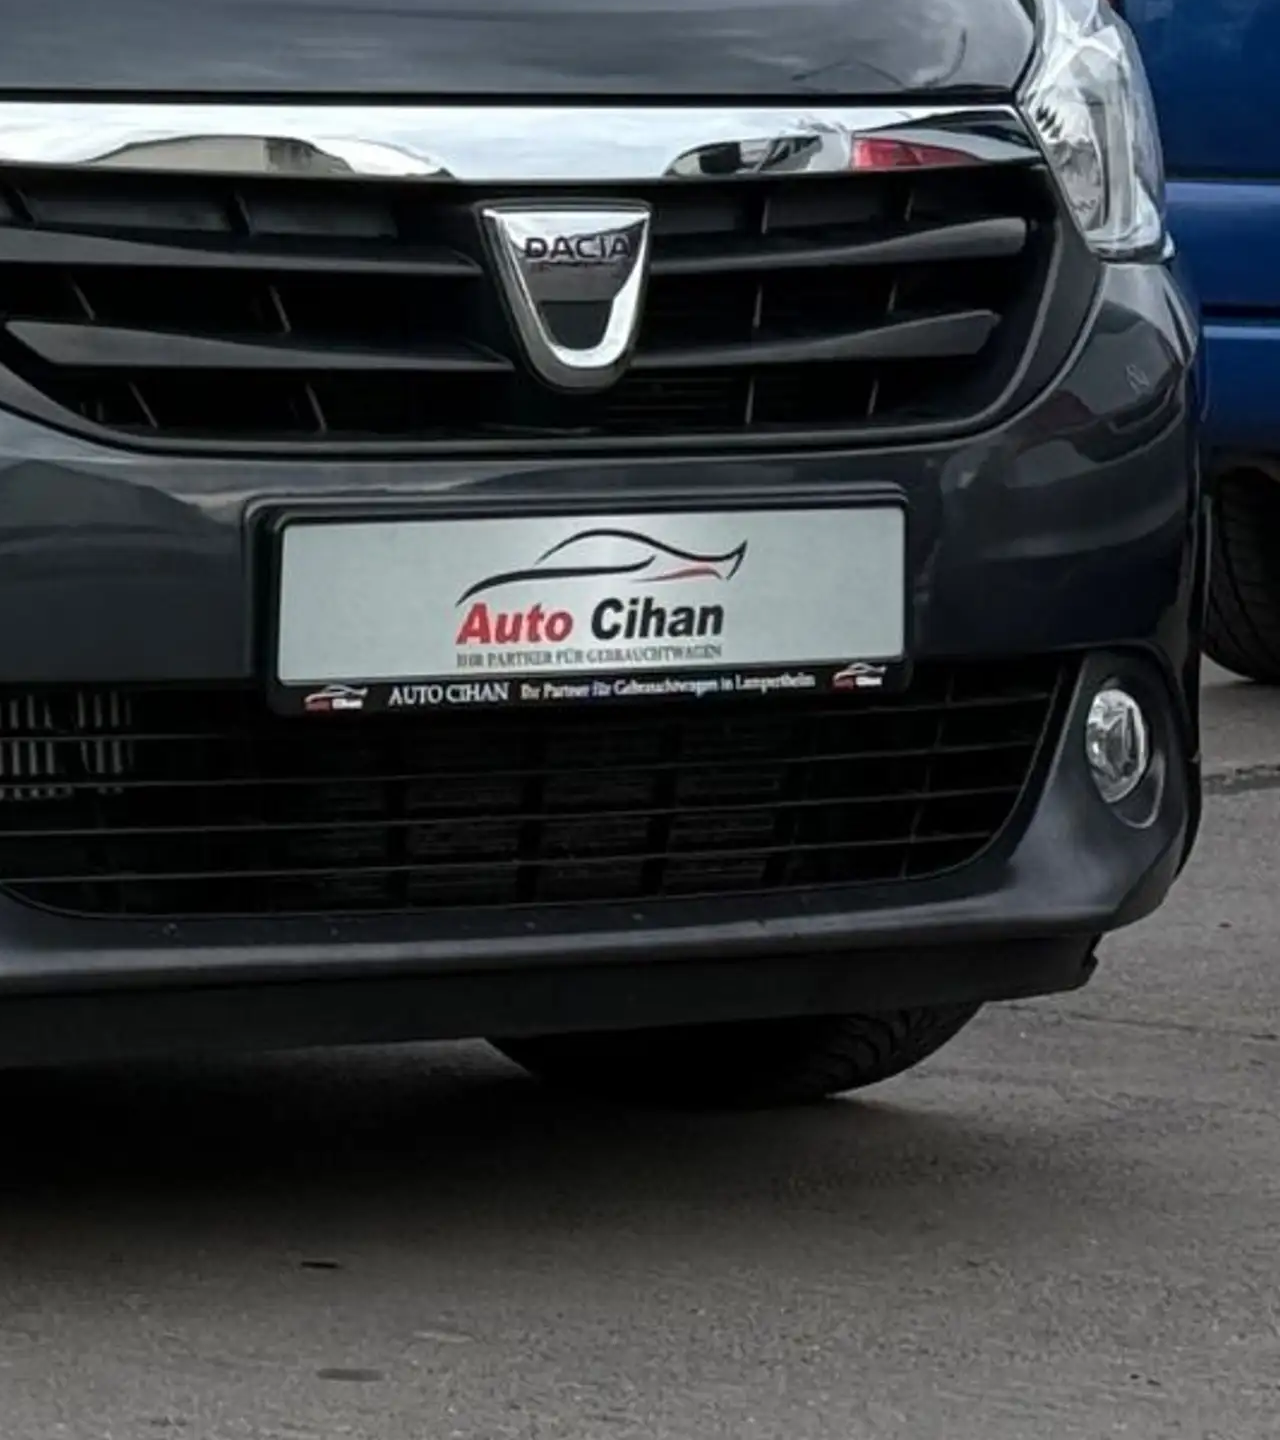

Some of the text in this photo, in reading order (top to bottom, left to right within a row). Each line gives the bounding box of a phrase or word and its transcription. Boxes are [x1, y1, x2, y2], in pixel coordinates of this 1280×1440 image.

[524, 235, 631, 259] DACIA
[455, 598, 724, 646] Auto Cihan
[388, 683, 444, 706] AUTO
[446, 681, 509, 703] CIHAN
